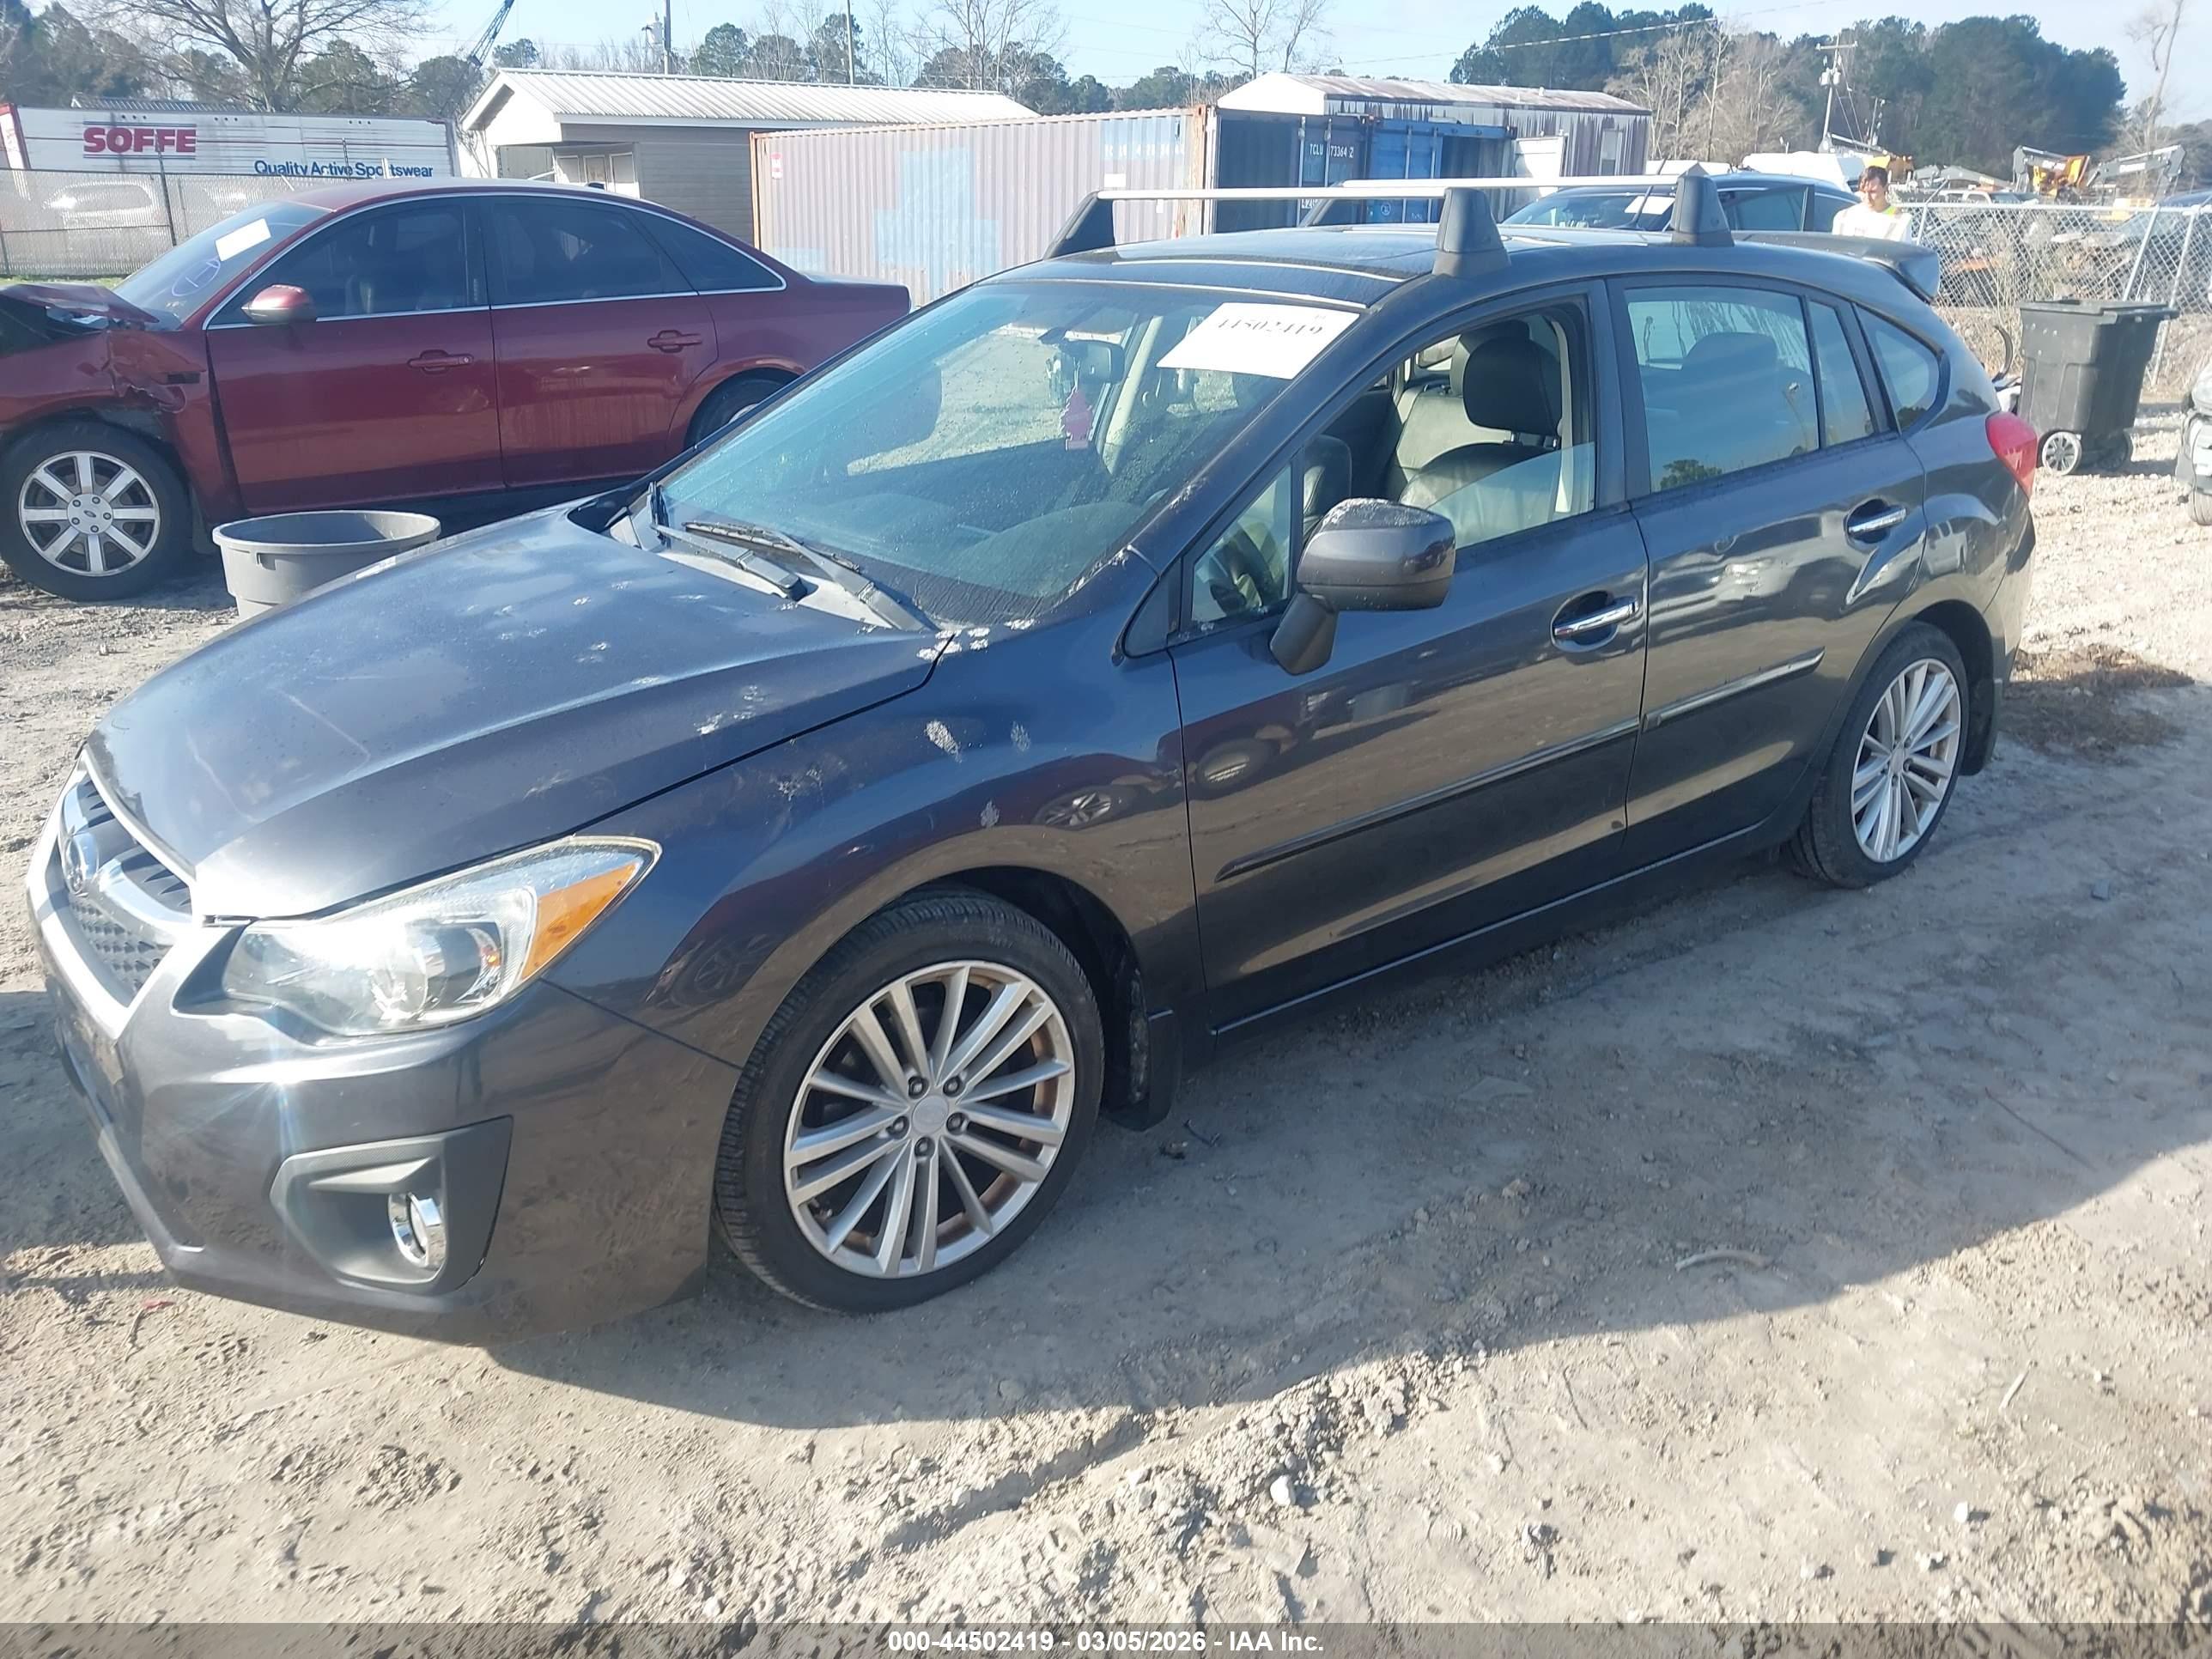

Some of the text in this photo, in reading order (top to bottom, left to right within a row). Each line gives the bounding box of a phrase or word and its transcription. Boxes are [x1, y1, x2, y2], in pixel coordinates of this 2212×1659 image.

[83, 127, 197, 153] SOFFE
[1310, 143, 1324, 155] TCLU
[1328, 144, 1347, 158] 73364
[254, 160, 434, 178] Quality Active Spotswear
